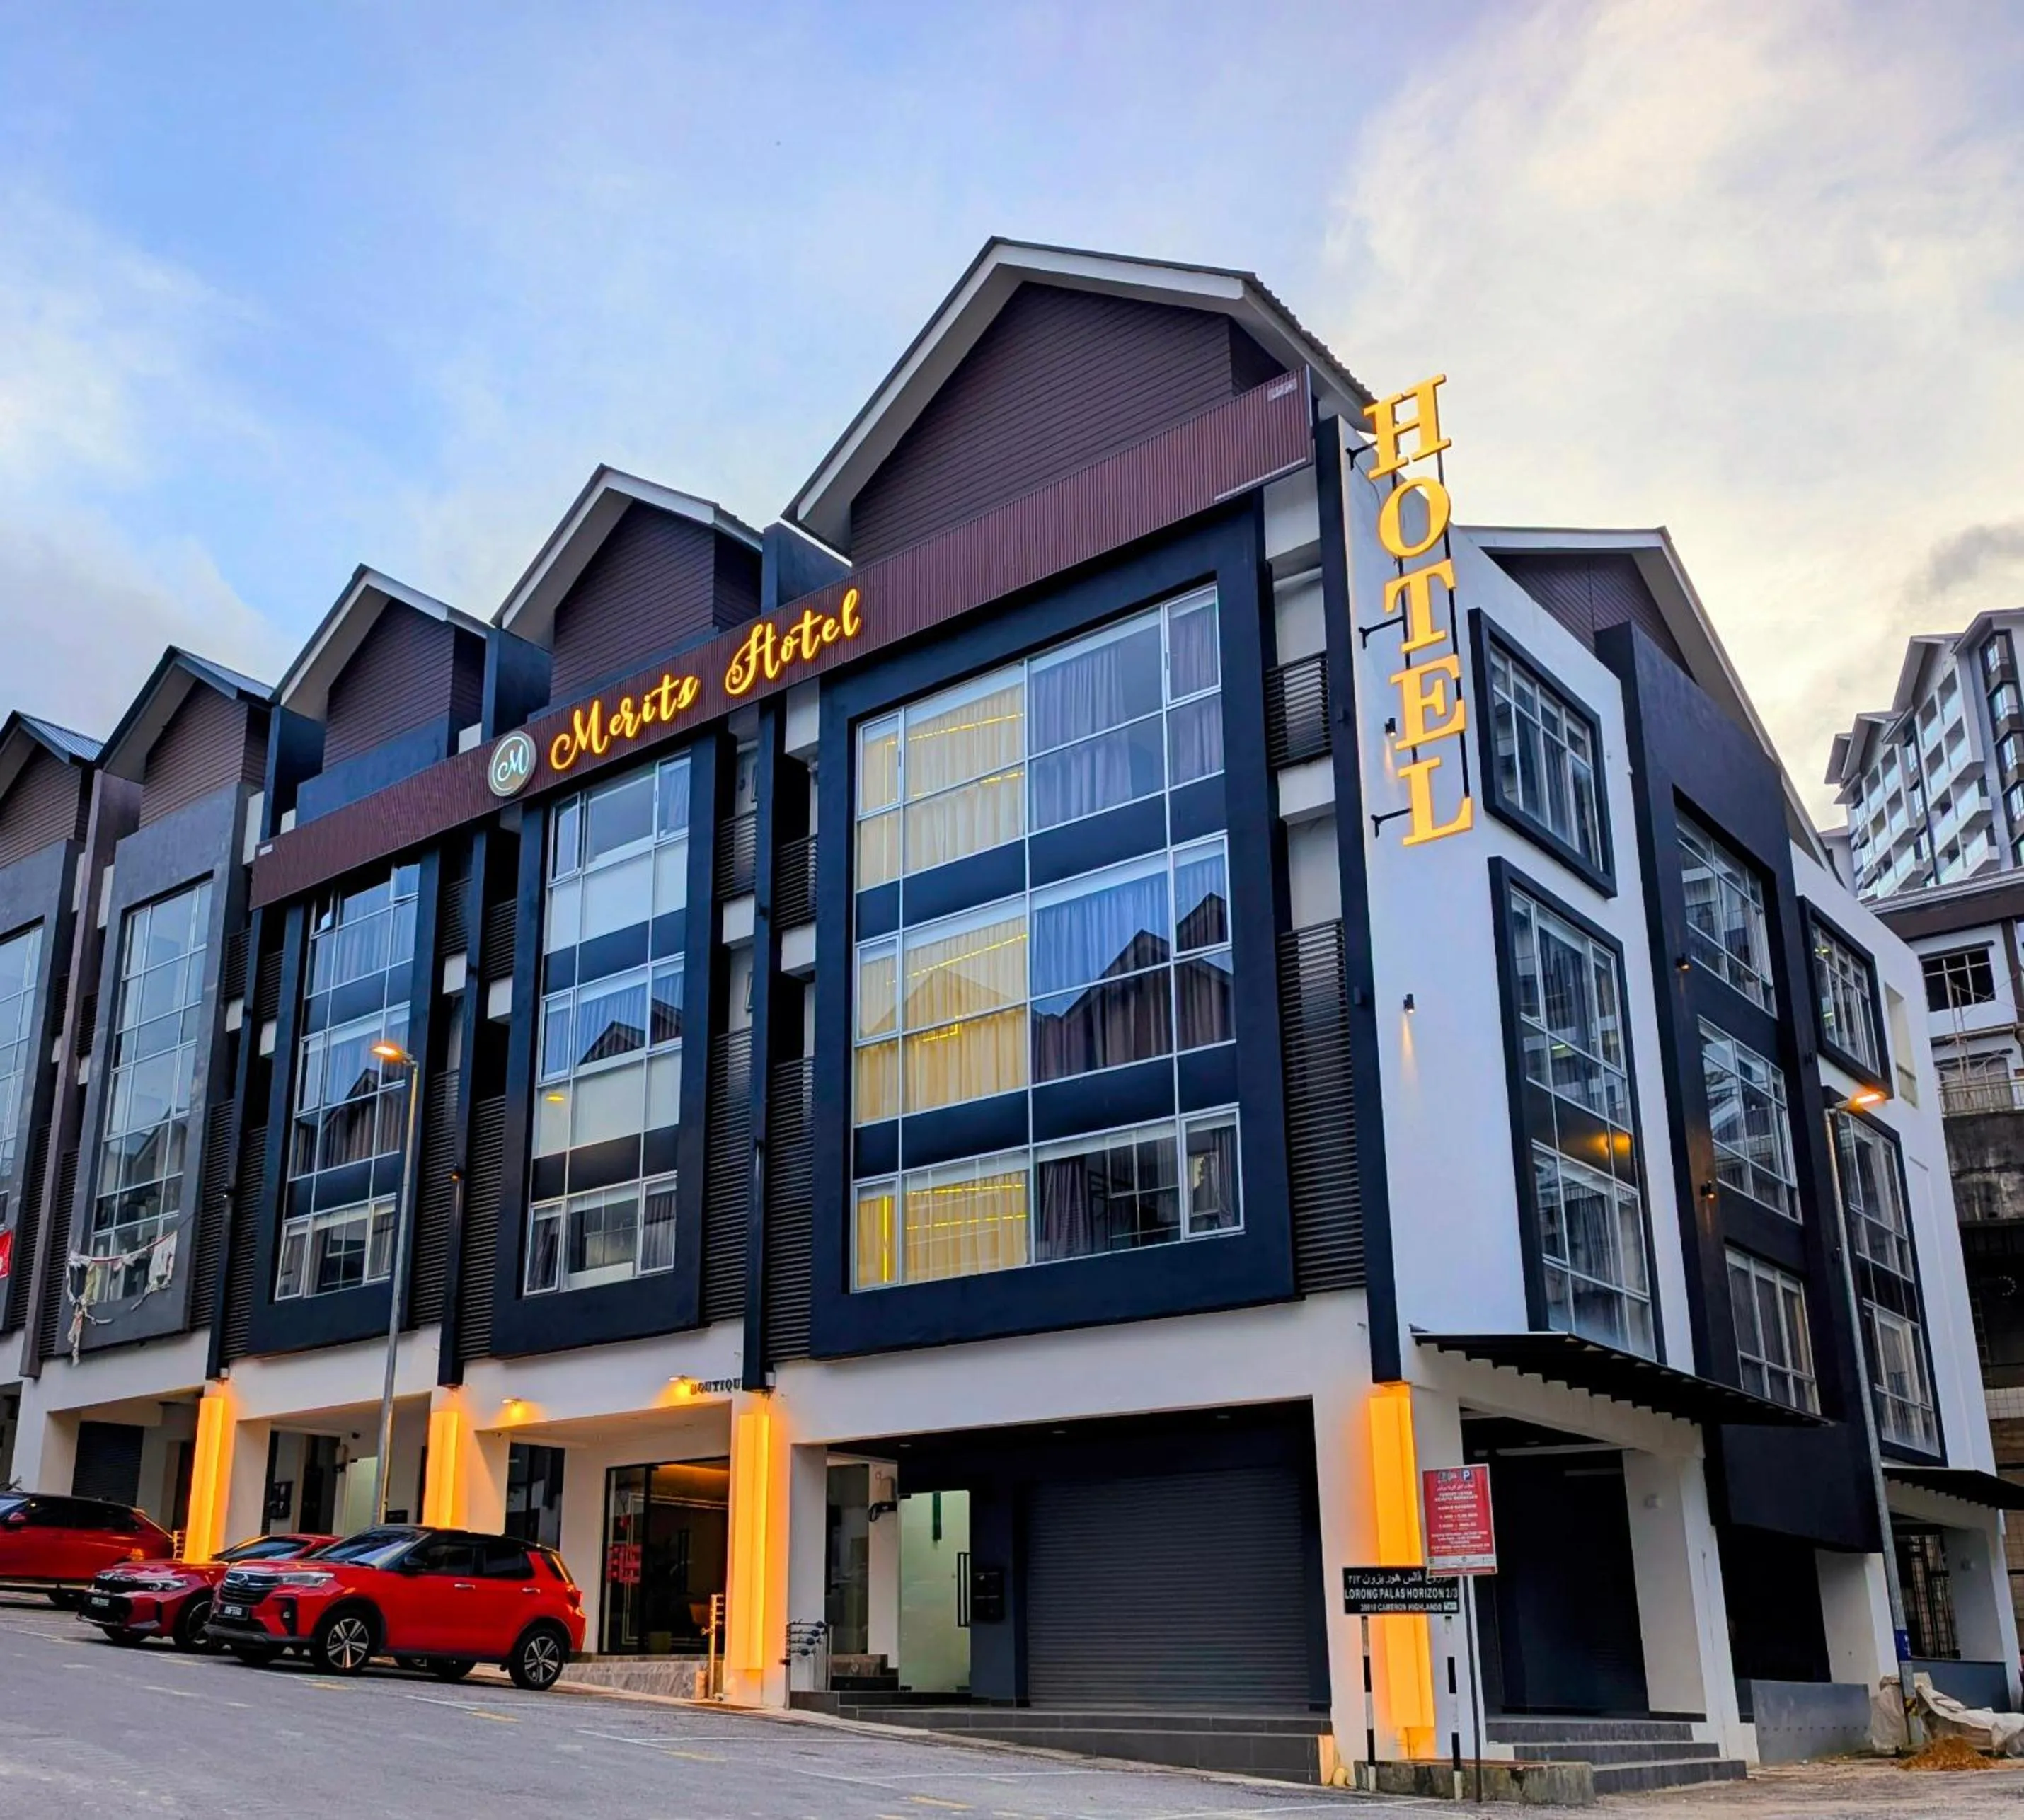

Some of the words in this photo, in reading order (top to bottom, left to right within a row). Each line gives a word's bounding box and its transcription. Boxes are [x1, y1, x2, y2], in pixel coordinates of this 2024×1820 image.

[1364, 374, 1473, 846] HOTEL
[551, 674, 699, 770] Merits
[725, 589, 861, 695] Hotel
[690, 1378, 742, 1395] BOUTIQU
[1345, 1588, 1378, 1599] LORONG
[1380, 1587, 1405, 1599] PALAS
[1407, 1587, 1444, 1599] HORIZON
[1446, 1587, 1458, 1598] 2/3
